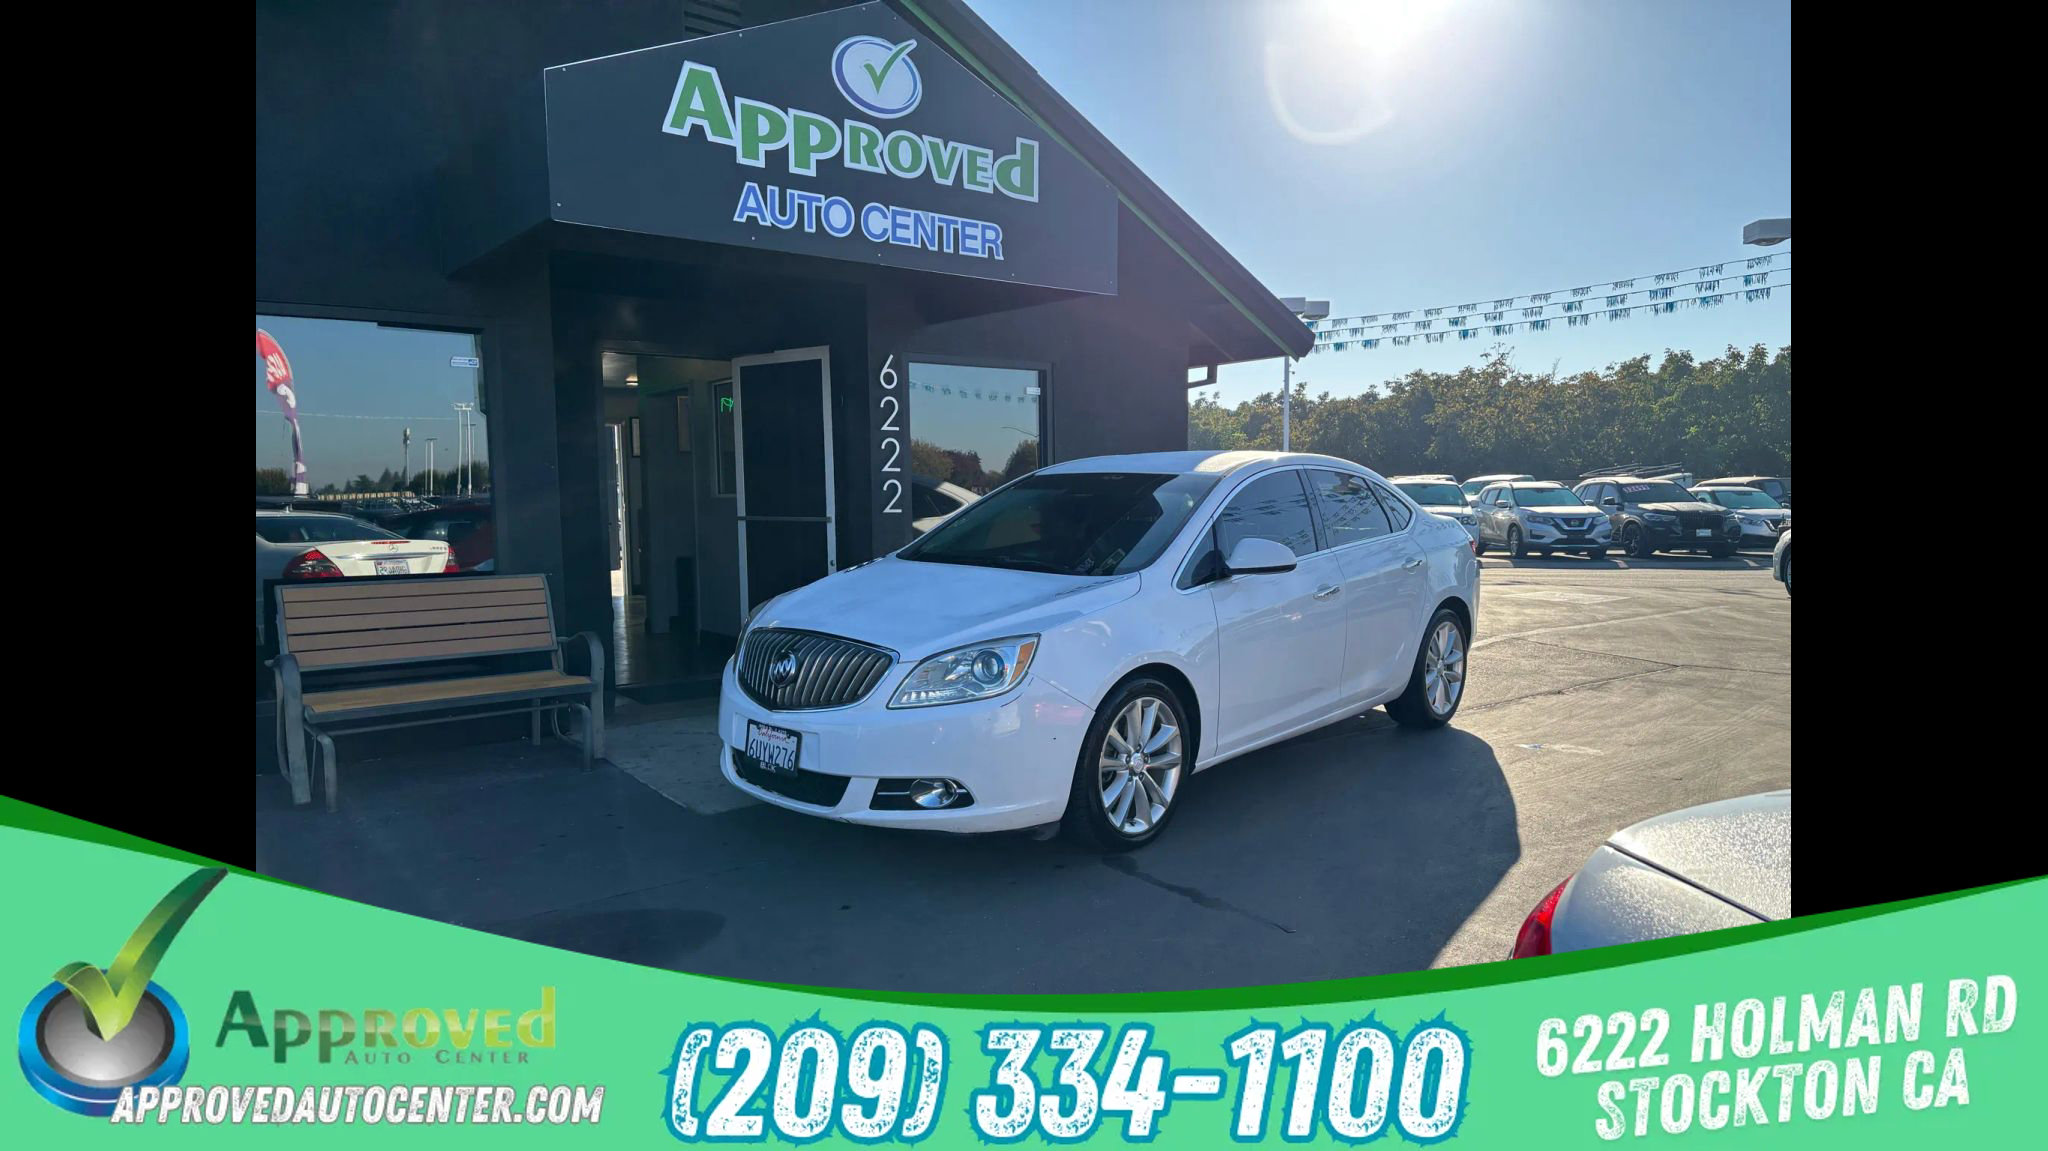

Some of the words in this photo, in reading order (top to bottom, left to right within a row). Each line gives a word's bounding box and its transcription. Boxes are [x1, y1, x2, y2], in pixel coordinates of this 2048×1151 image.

[733, 181, 855, 238] AUTO
[861, 202, 1005, 261] CENTER
[879, 354, 903, 514] 6222
[748, 738, 795, 769] 6UYW276
